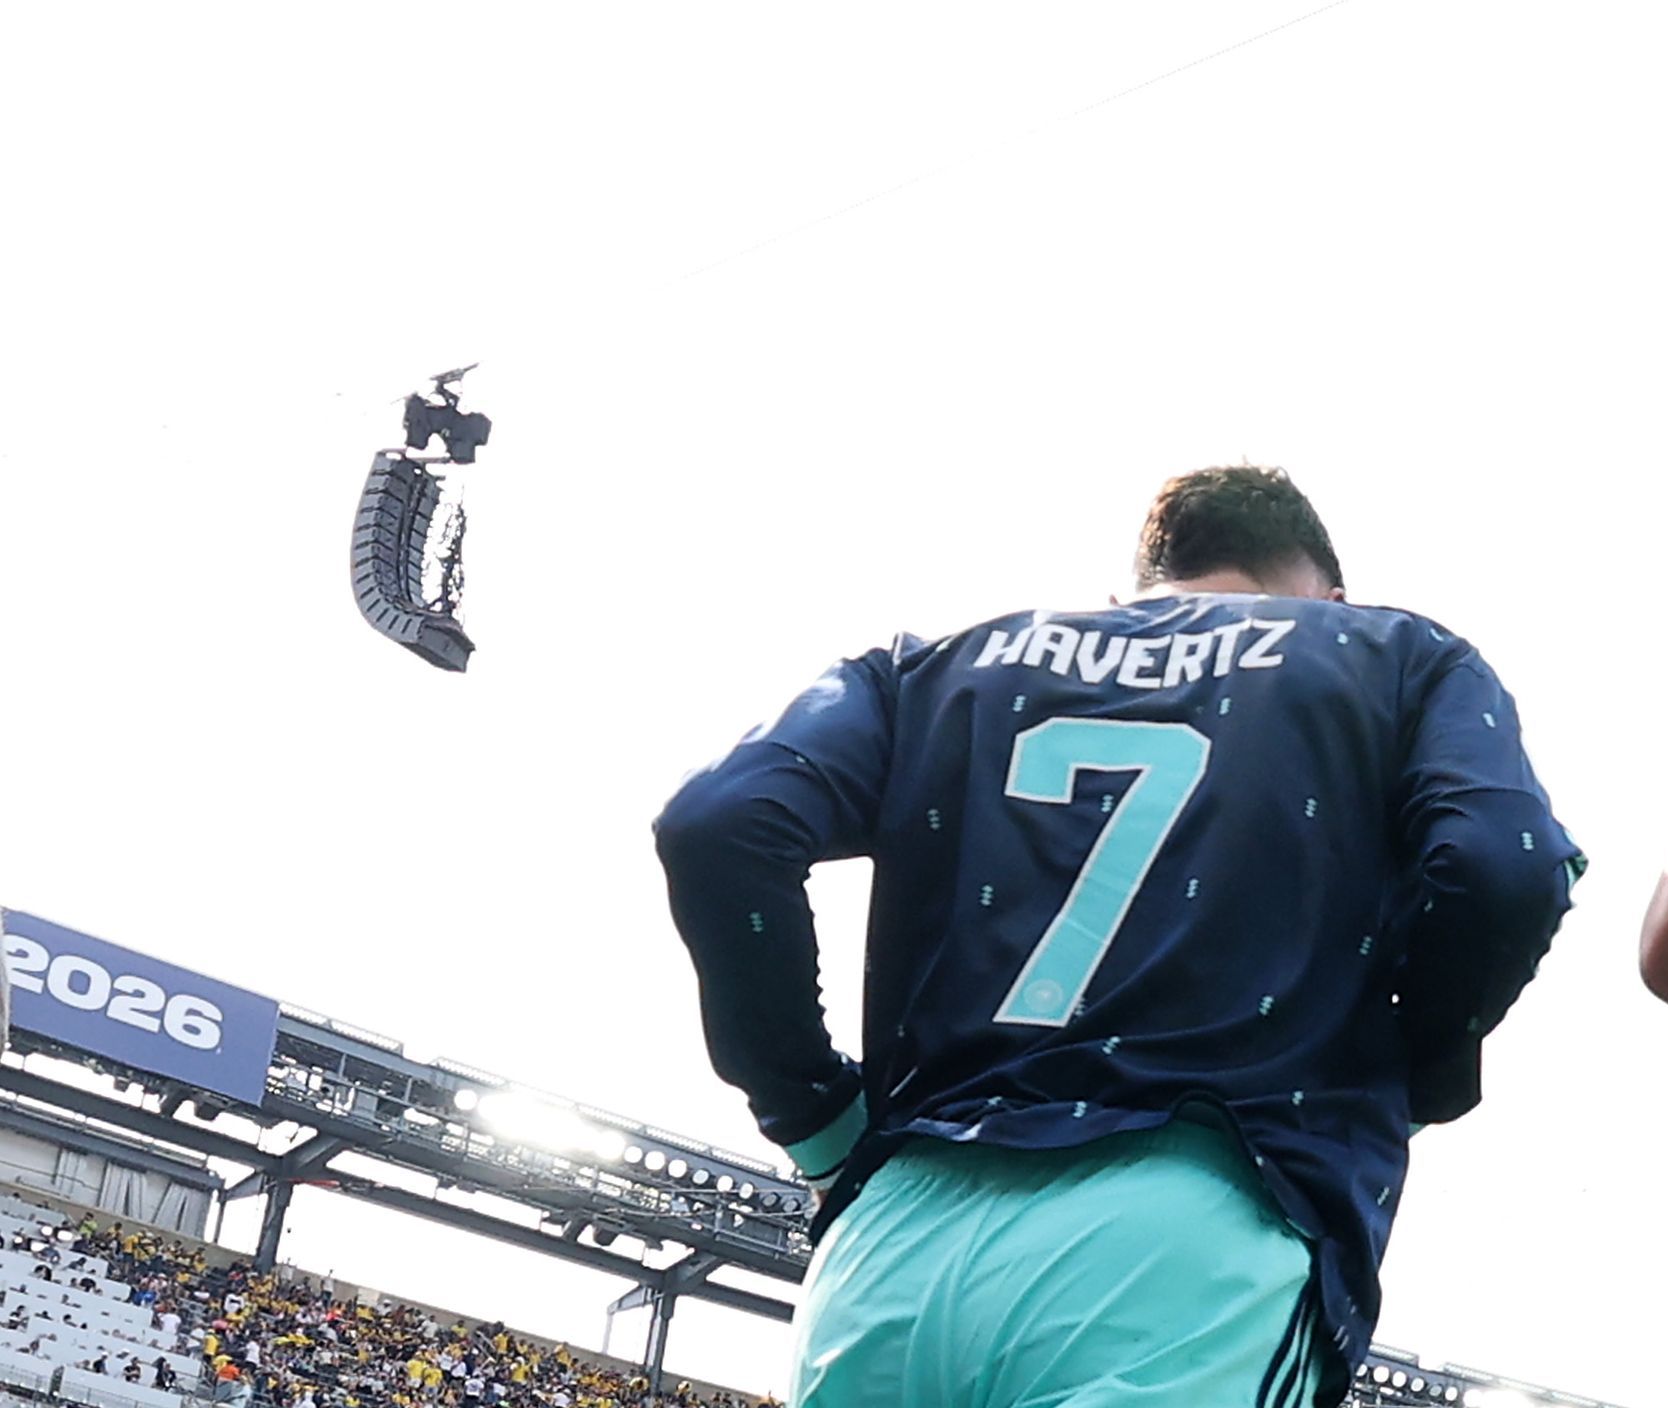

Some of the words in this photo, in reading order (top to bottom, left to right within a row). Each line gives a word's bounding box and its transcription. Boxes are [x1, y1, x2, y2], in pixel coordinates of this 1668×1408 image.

[973, 618, 1297, 689] HAVERTZ
[992, 717, 1212, 1028] 7
[3, 933, 223, 1050] 2026
